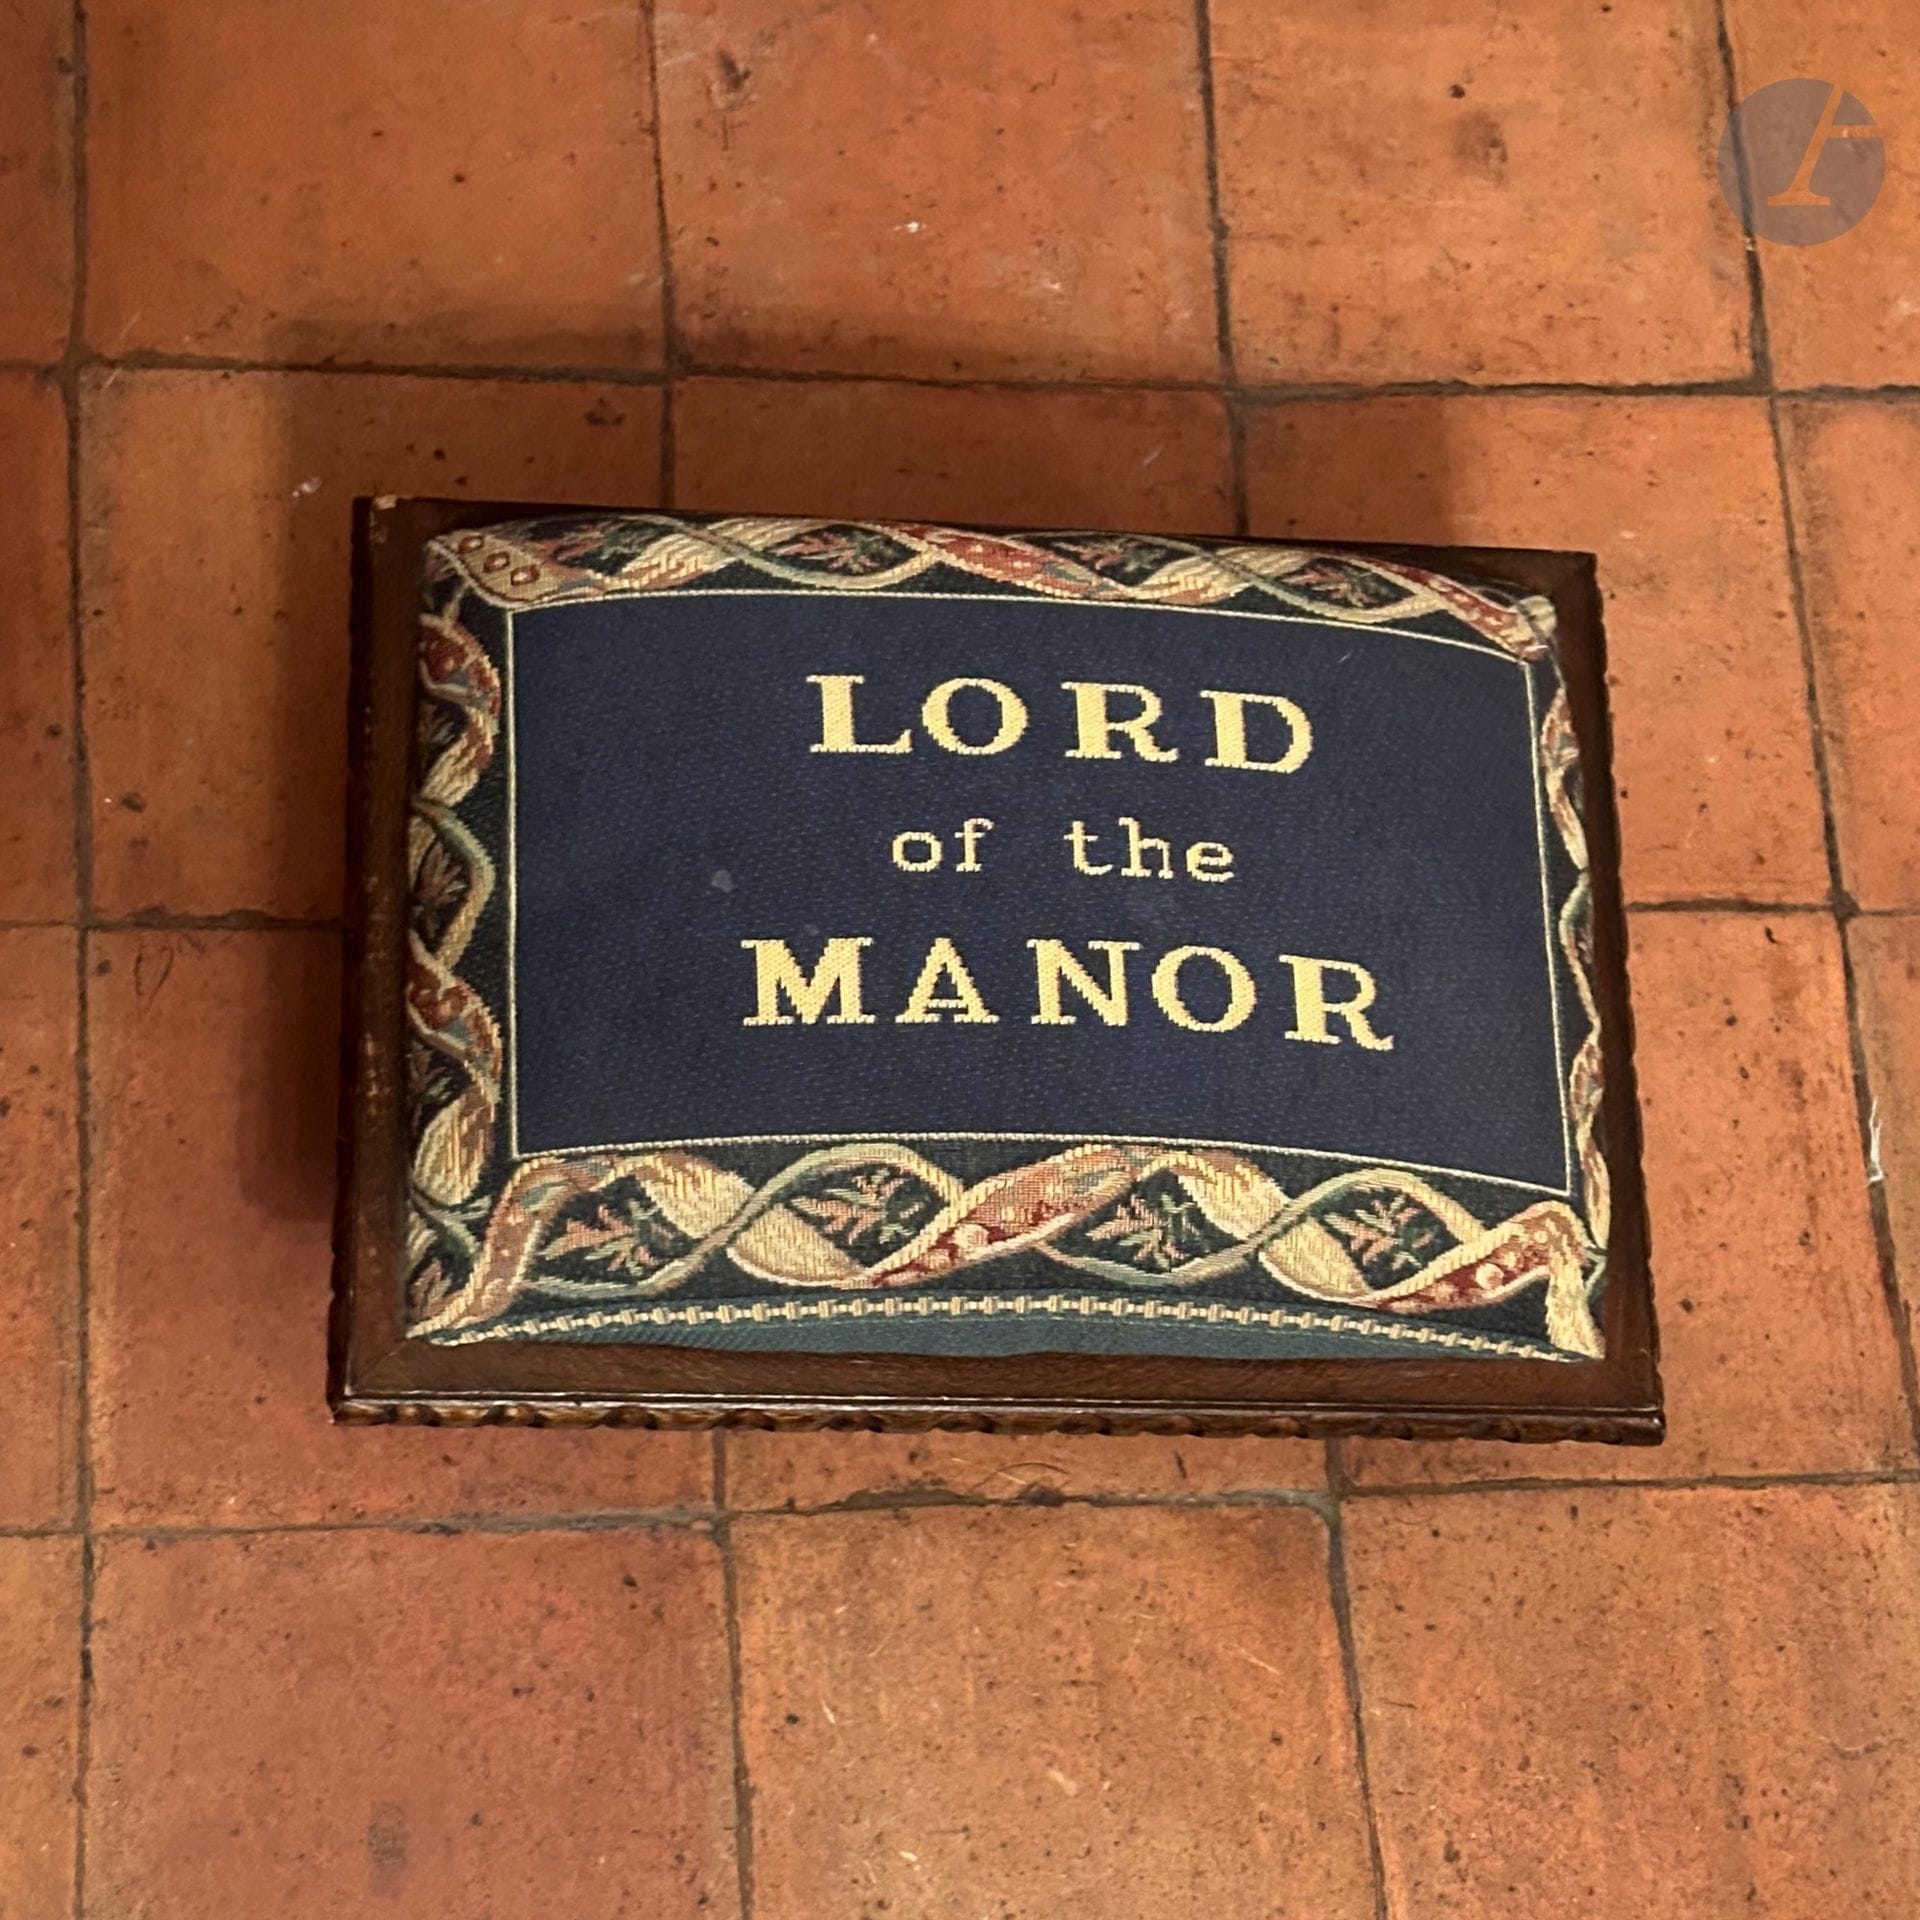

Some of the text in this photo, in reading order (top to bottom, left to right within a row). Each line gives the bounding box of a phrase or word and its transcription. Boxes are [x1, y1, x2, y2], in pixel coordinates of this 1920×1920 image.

[806, 673, 1315, 775] LORD
[891, 815, 1235, 883] of the
[741, 936, 1395, 1052] MANOR
